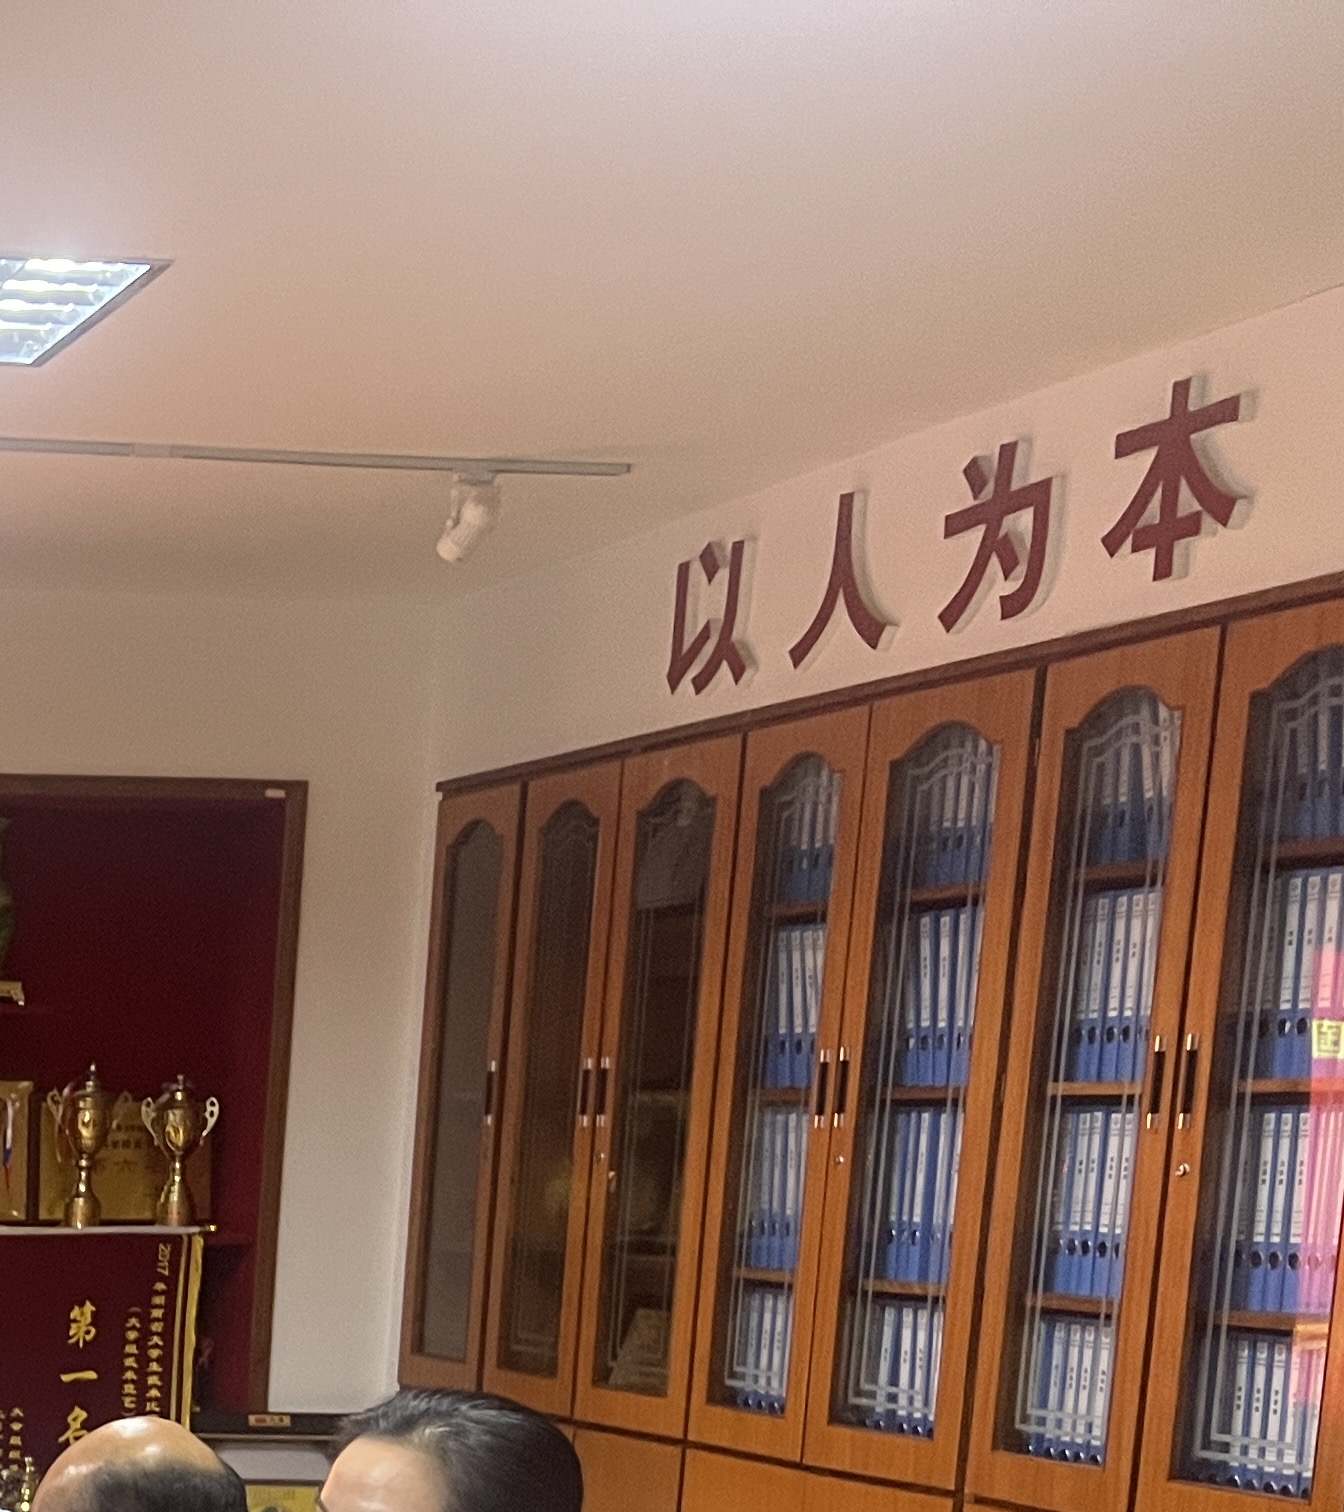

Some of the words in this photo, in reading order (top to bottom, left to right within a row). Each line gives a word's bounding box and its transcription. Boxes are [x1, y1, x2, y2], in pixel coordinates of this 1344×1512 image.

[667, 377, 1241, 696] 以人为本
[58, 1299, 99, 1445] 第一名
